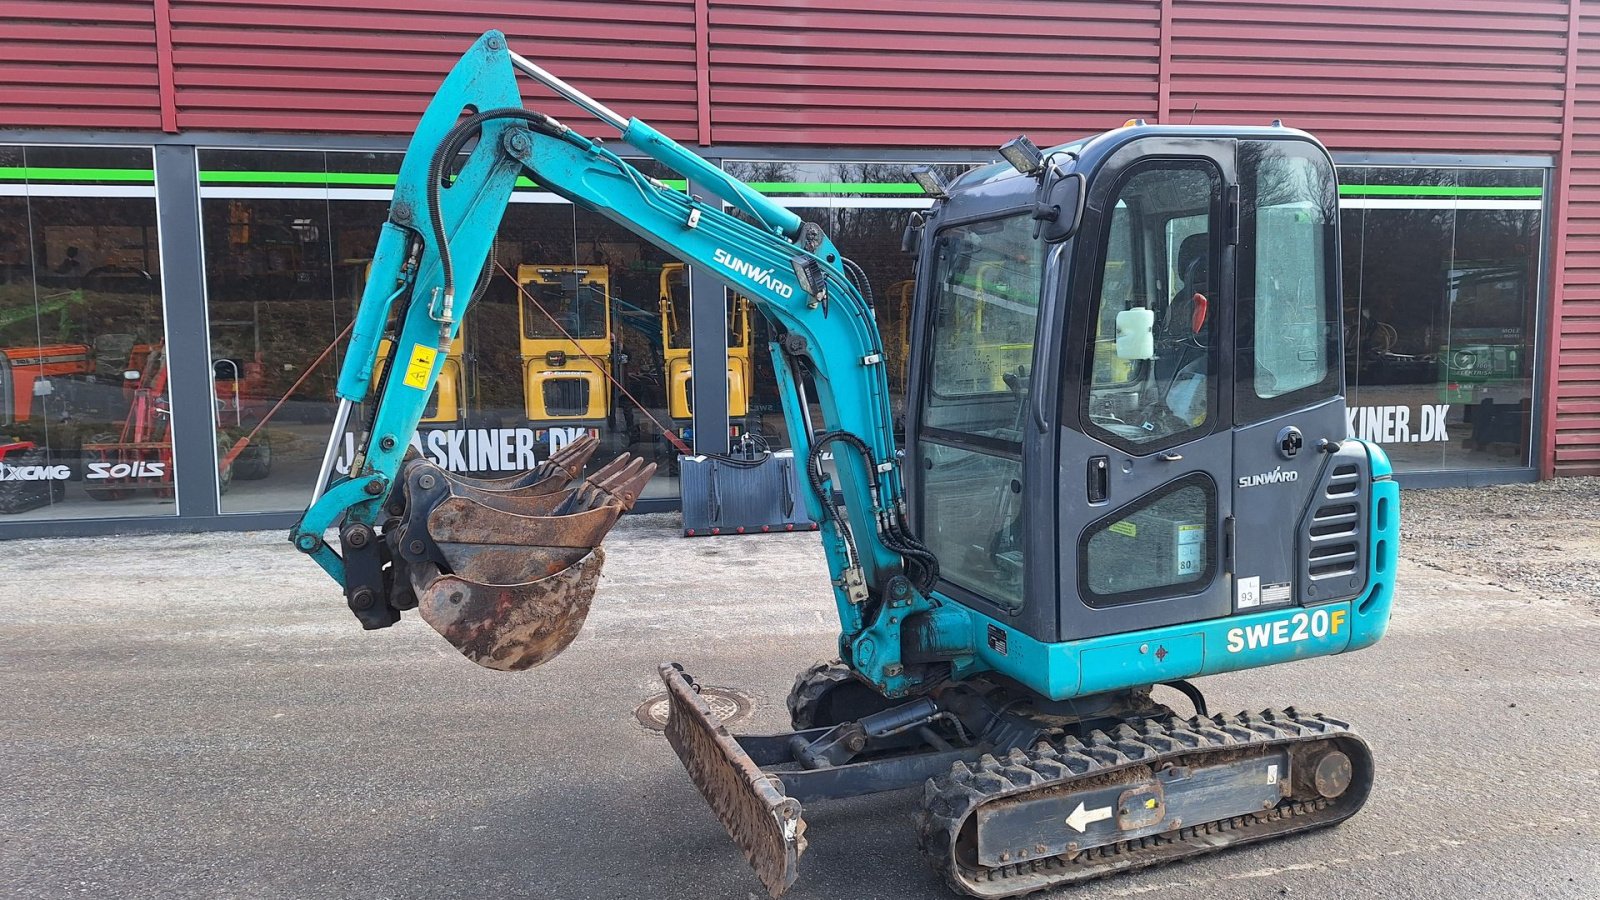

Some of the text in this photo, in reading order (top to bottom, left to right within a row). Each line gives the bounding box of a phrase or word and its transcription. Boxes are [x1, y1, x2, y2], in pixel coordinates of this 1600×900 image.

[713, 248, 793, 299] SUNWARD
[1346, 404, 1450, 443] KINER.DK
[4, 464, 71, 481] XCMG
[1238, 465, 1299, 488] SUNWARD
[1180, 560, 1192, 570] 80
[1241, 591, 1253, 602] 93
[1226, 609, 1347, 653] SWE20F
